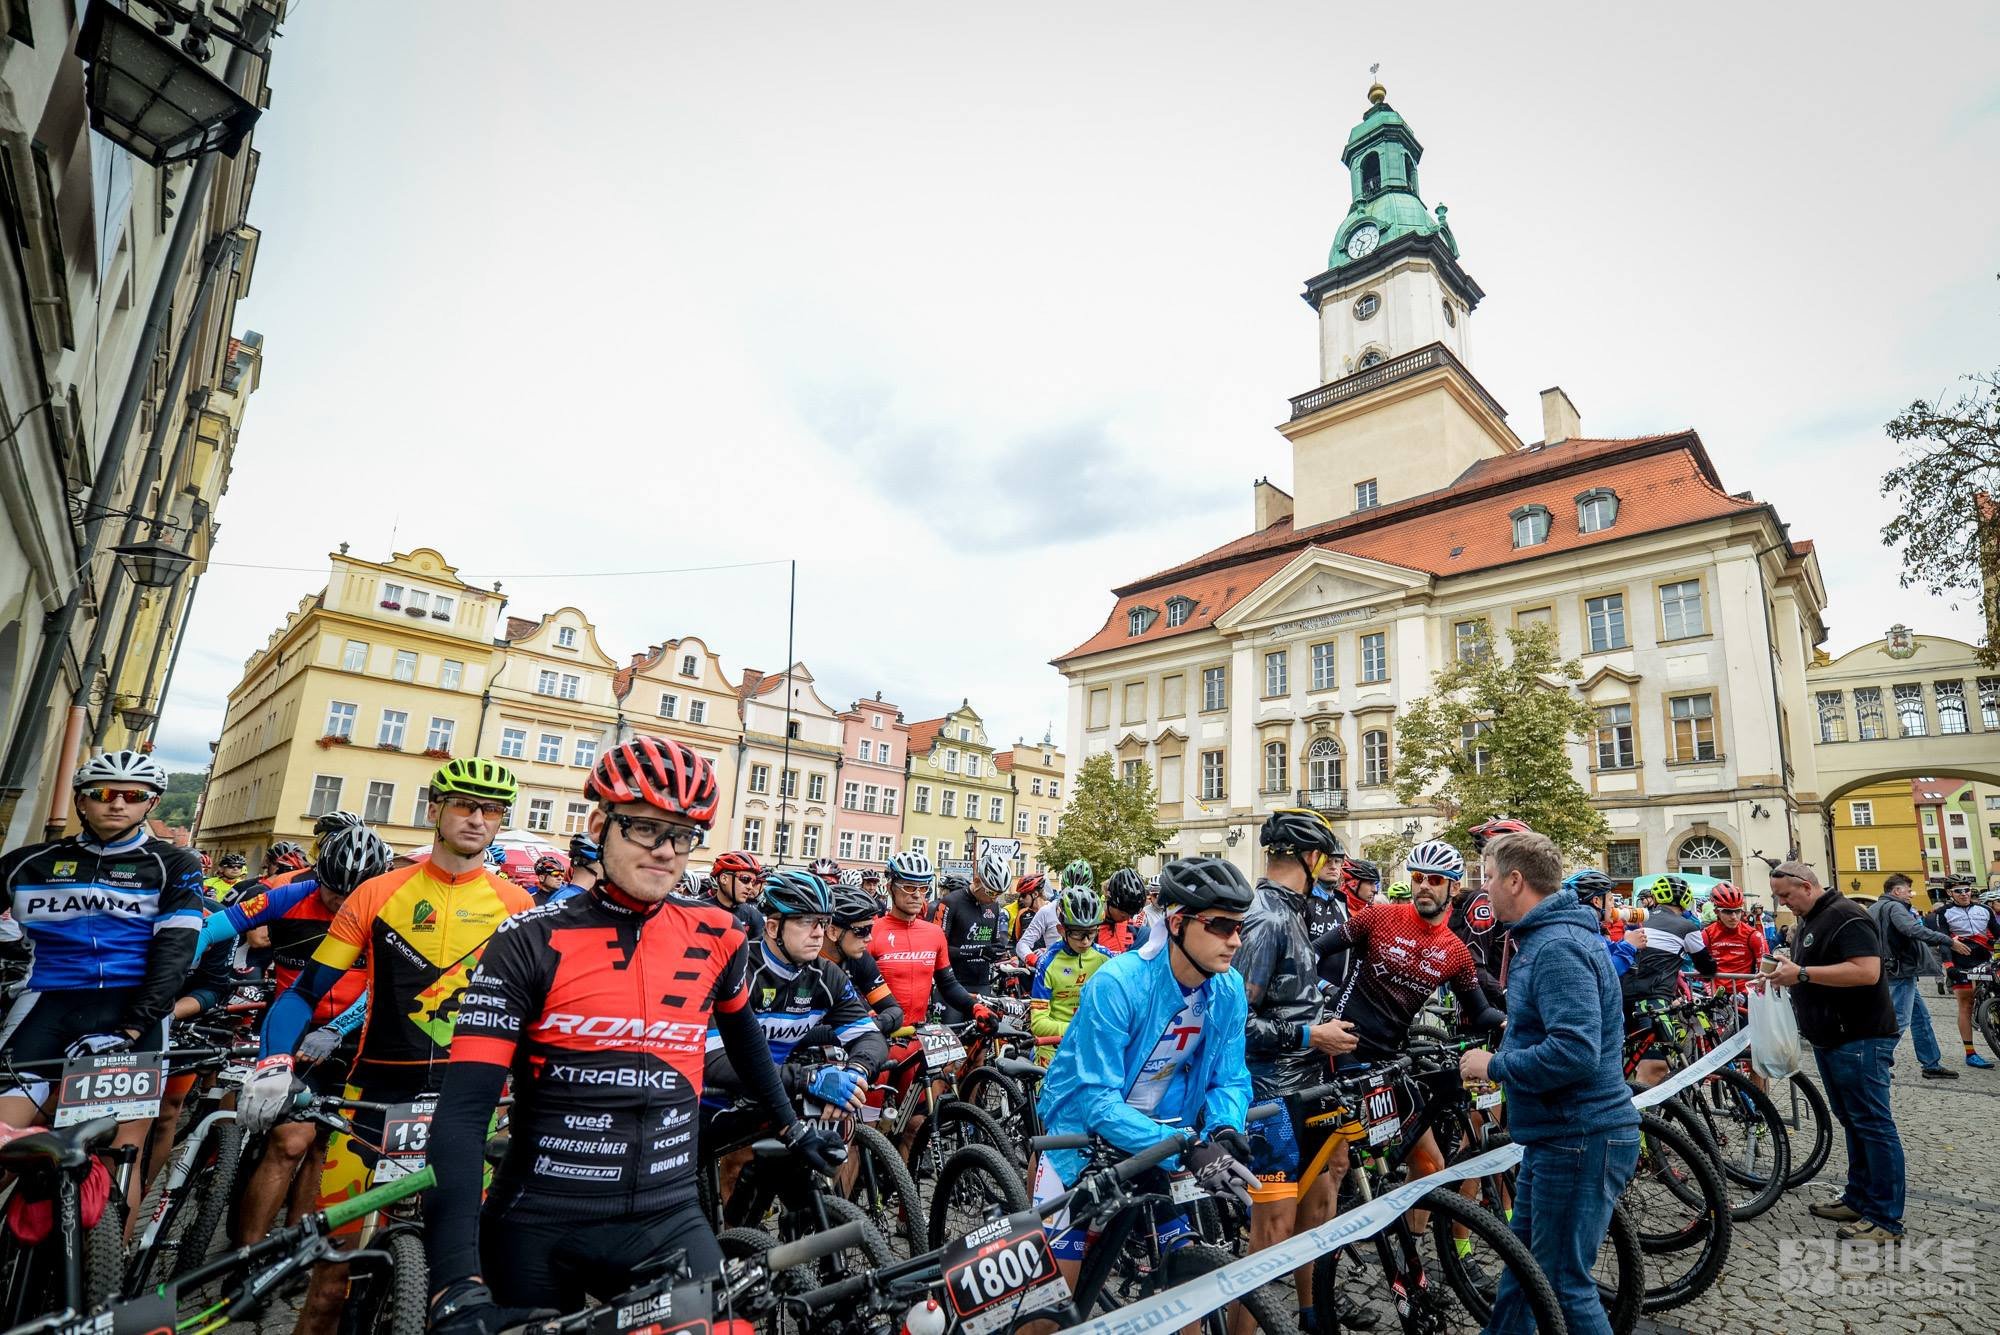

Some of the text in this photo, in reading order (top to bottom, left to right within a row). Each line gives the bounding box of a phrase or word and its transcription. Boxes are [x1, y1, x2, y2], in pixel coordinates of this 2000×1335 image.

[981, 839, 1021, 860] 2 SEKTOR 2
[27, 894, 142, 915] PŁAWNA
[601, 900, 633, 915] ROMET
[496, 898, 569, 934] quest
[980, 925, 993, 935] bike
[394, 940, 428, 970] ANCHEM
[880, 951, 937, 960] SPECIALIZED
[1390, 975, 1432, 996] MARCO
[538, 1012, 708, 1042] ROMET
[595, 1038, 699, 1052] FACTORY TEAM
[108, 1055, 138, 1063] BIKE
[1143, 1061, 1166, 1071] SAP
[75, 1072, 150, 1100] 1596
[550, 1064, 678, 1090] XTRABIKE
[1369, 1091, 1394, 1120] 1011
[564, 1112, 614, 1131] quest
[538, 1135, 629, 1155] GERRESHEIMER
[653, 1131, 691, 1150] KORE
[551, 1163, 619, 1177] MICHELIN
[978, 1217, 1010, 1237] BIKE
[980, 1225, 1012, 1244] maraton
[960, 1240, 1043, 1306] 1800
[632, 1292, 673, 1317] BIKE
[632, 1307, 673, 1325] maraton
